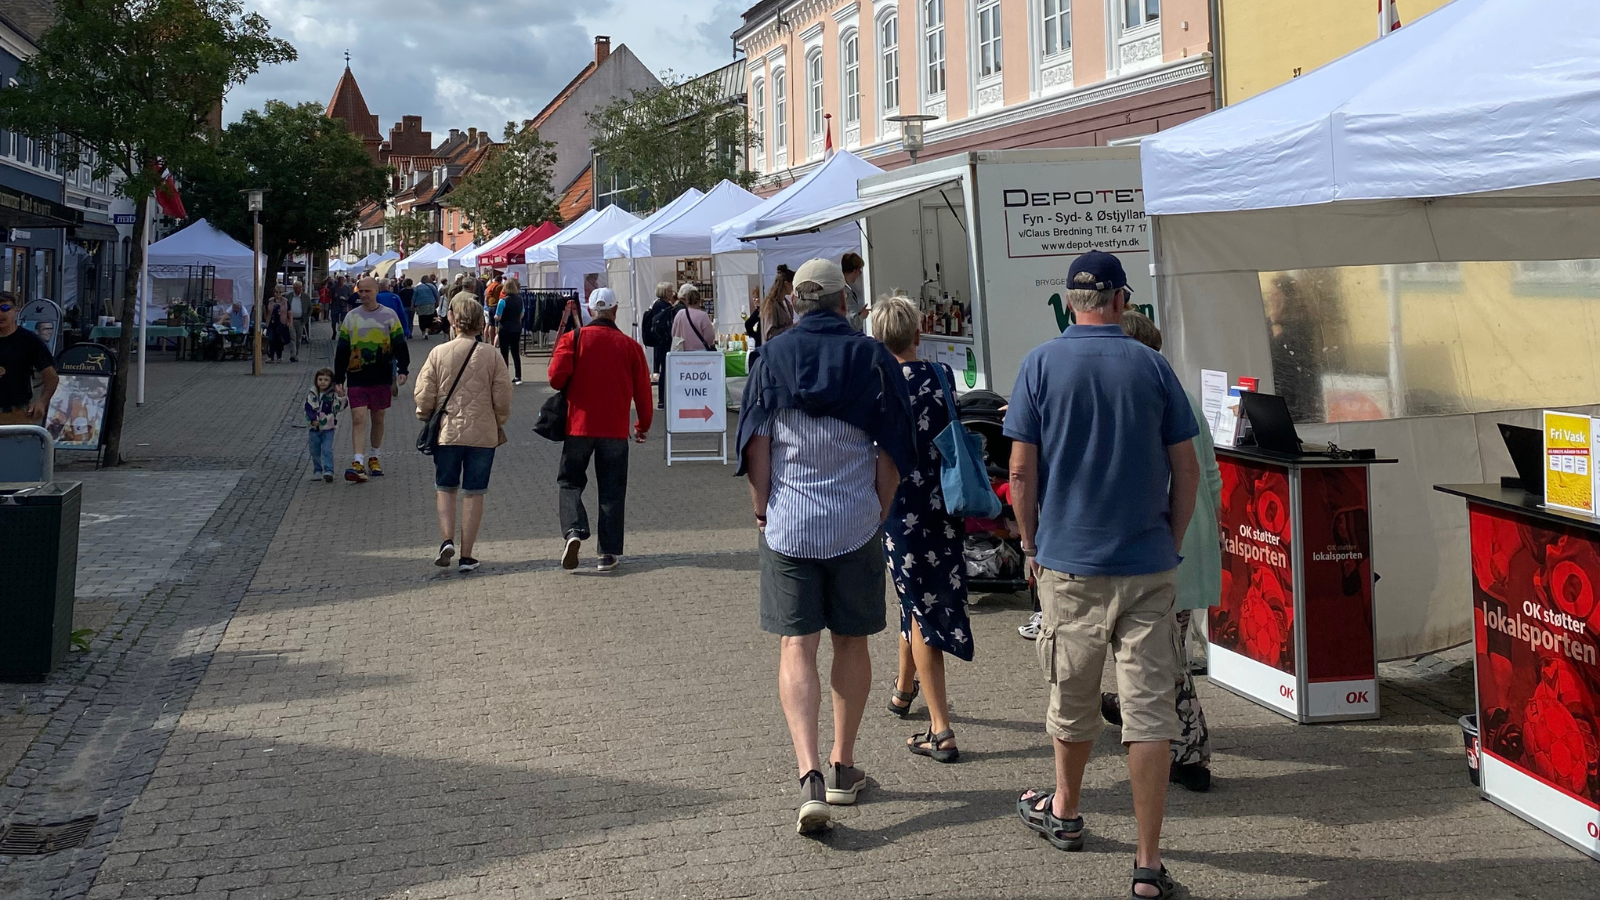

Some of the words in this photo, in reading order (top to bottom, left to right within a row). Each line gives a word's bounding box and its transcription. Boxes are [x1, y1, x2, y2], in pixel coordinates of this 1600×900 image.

[1022, 214, 1044, 226] Fyn
[1055, 212, 1082, 225] Syd-
[1085, 211, 1093, 222] &
[1097, 209, 1146, 222] Østjyllan
[1018, 229, 1050, 238] v/Claus
[1053, 228, 1093, 237] Bredning
[1095, 226, 1109, 234] Tlf.
[1111, 225, 1123, 234] 64
[1125, 224, 1135, 233] 77
[1138, 224, 1147, 232] 17
[1041, 238, 1140, 251] www.depot-vestfyn.dk
[1035, 279, 1067, 287] BRYGGE
[62, 362, 96, 371] Interflora
[679, 371, 712, 381] FADØL
[684, 388, 708, 397] VINE
[1550, 429, 1562, 440] Fri
[1564, 430, 1586, 443] Vask
[1239, 524, 1252, 539] OK
[1252, 529, 1280, 546] støtter
[1222, 532, 1287, 569] kalsporten
[1312, 551, 1363, 562] lokalsporten
[1523, 600, 1542, 620] OK
[1543, 609, 1586, 634] støtter
[1483, 601, 1596, 666] lokalsporten
[1279, 684, 1294, 700] OK
[1345, 691, 1369, 704] OK
[1587, 822, 1600, 841] O
